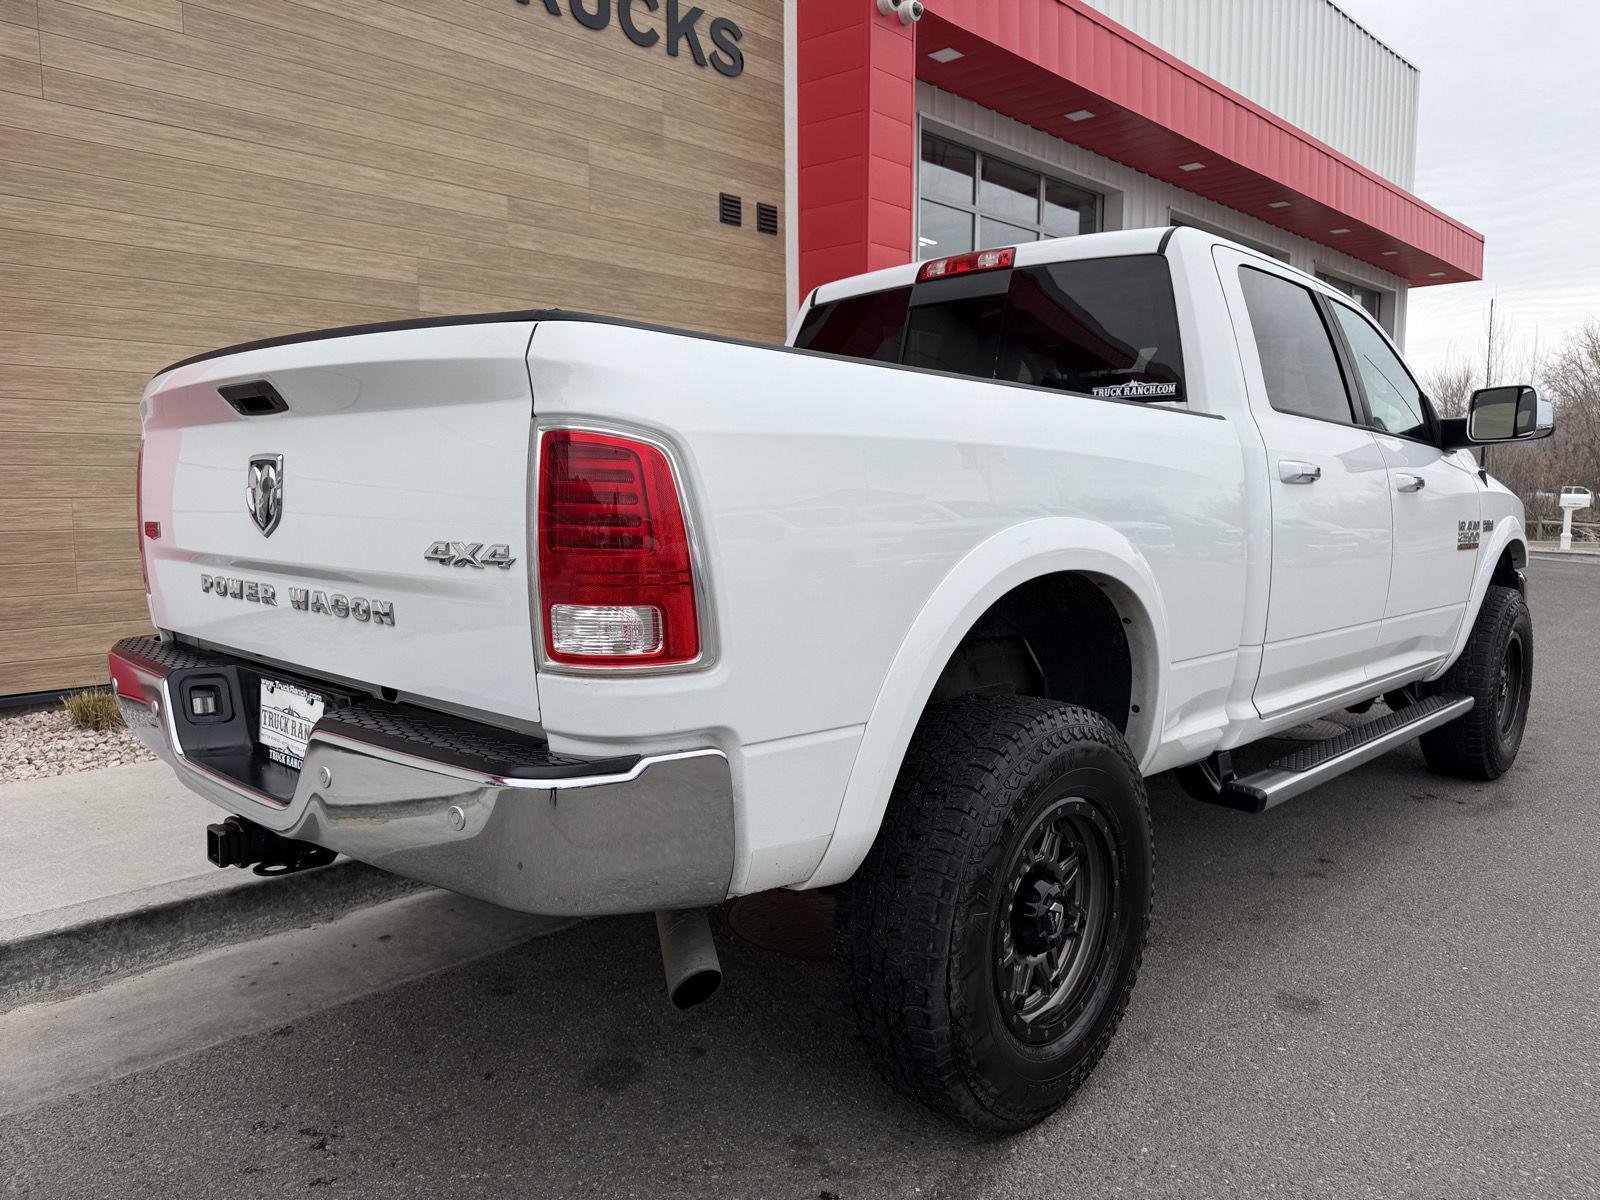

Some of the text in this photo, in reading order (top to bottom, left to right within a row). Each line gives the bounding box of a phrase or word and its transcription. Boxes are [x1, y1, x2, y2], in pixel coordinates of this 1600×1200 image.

[515, 0, 744, 77] UCKS
[1092, 384, 1176, 397] TRUCK RANCH.COM
[1458, 519, 1480, 531] RAM
[201, 573, 396, 627] POWER WAGON
[262, 709, 290, 735] TRUCK
[269, 749, 286, 765] TRUCK
